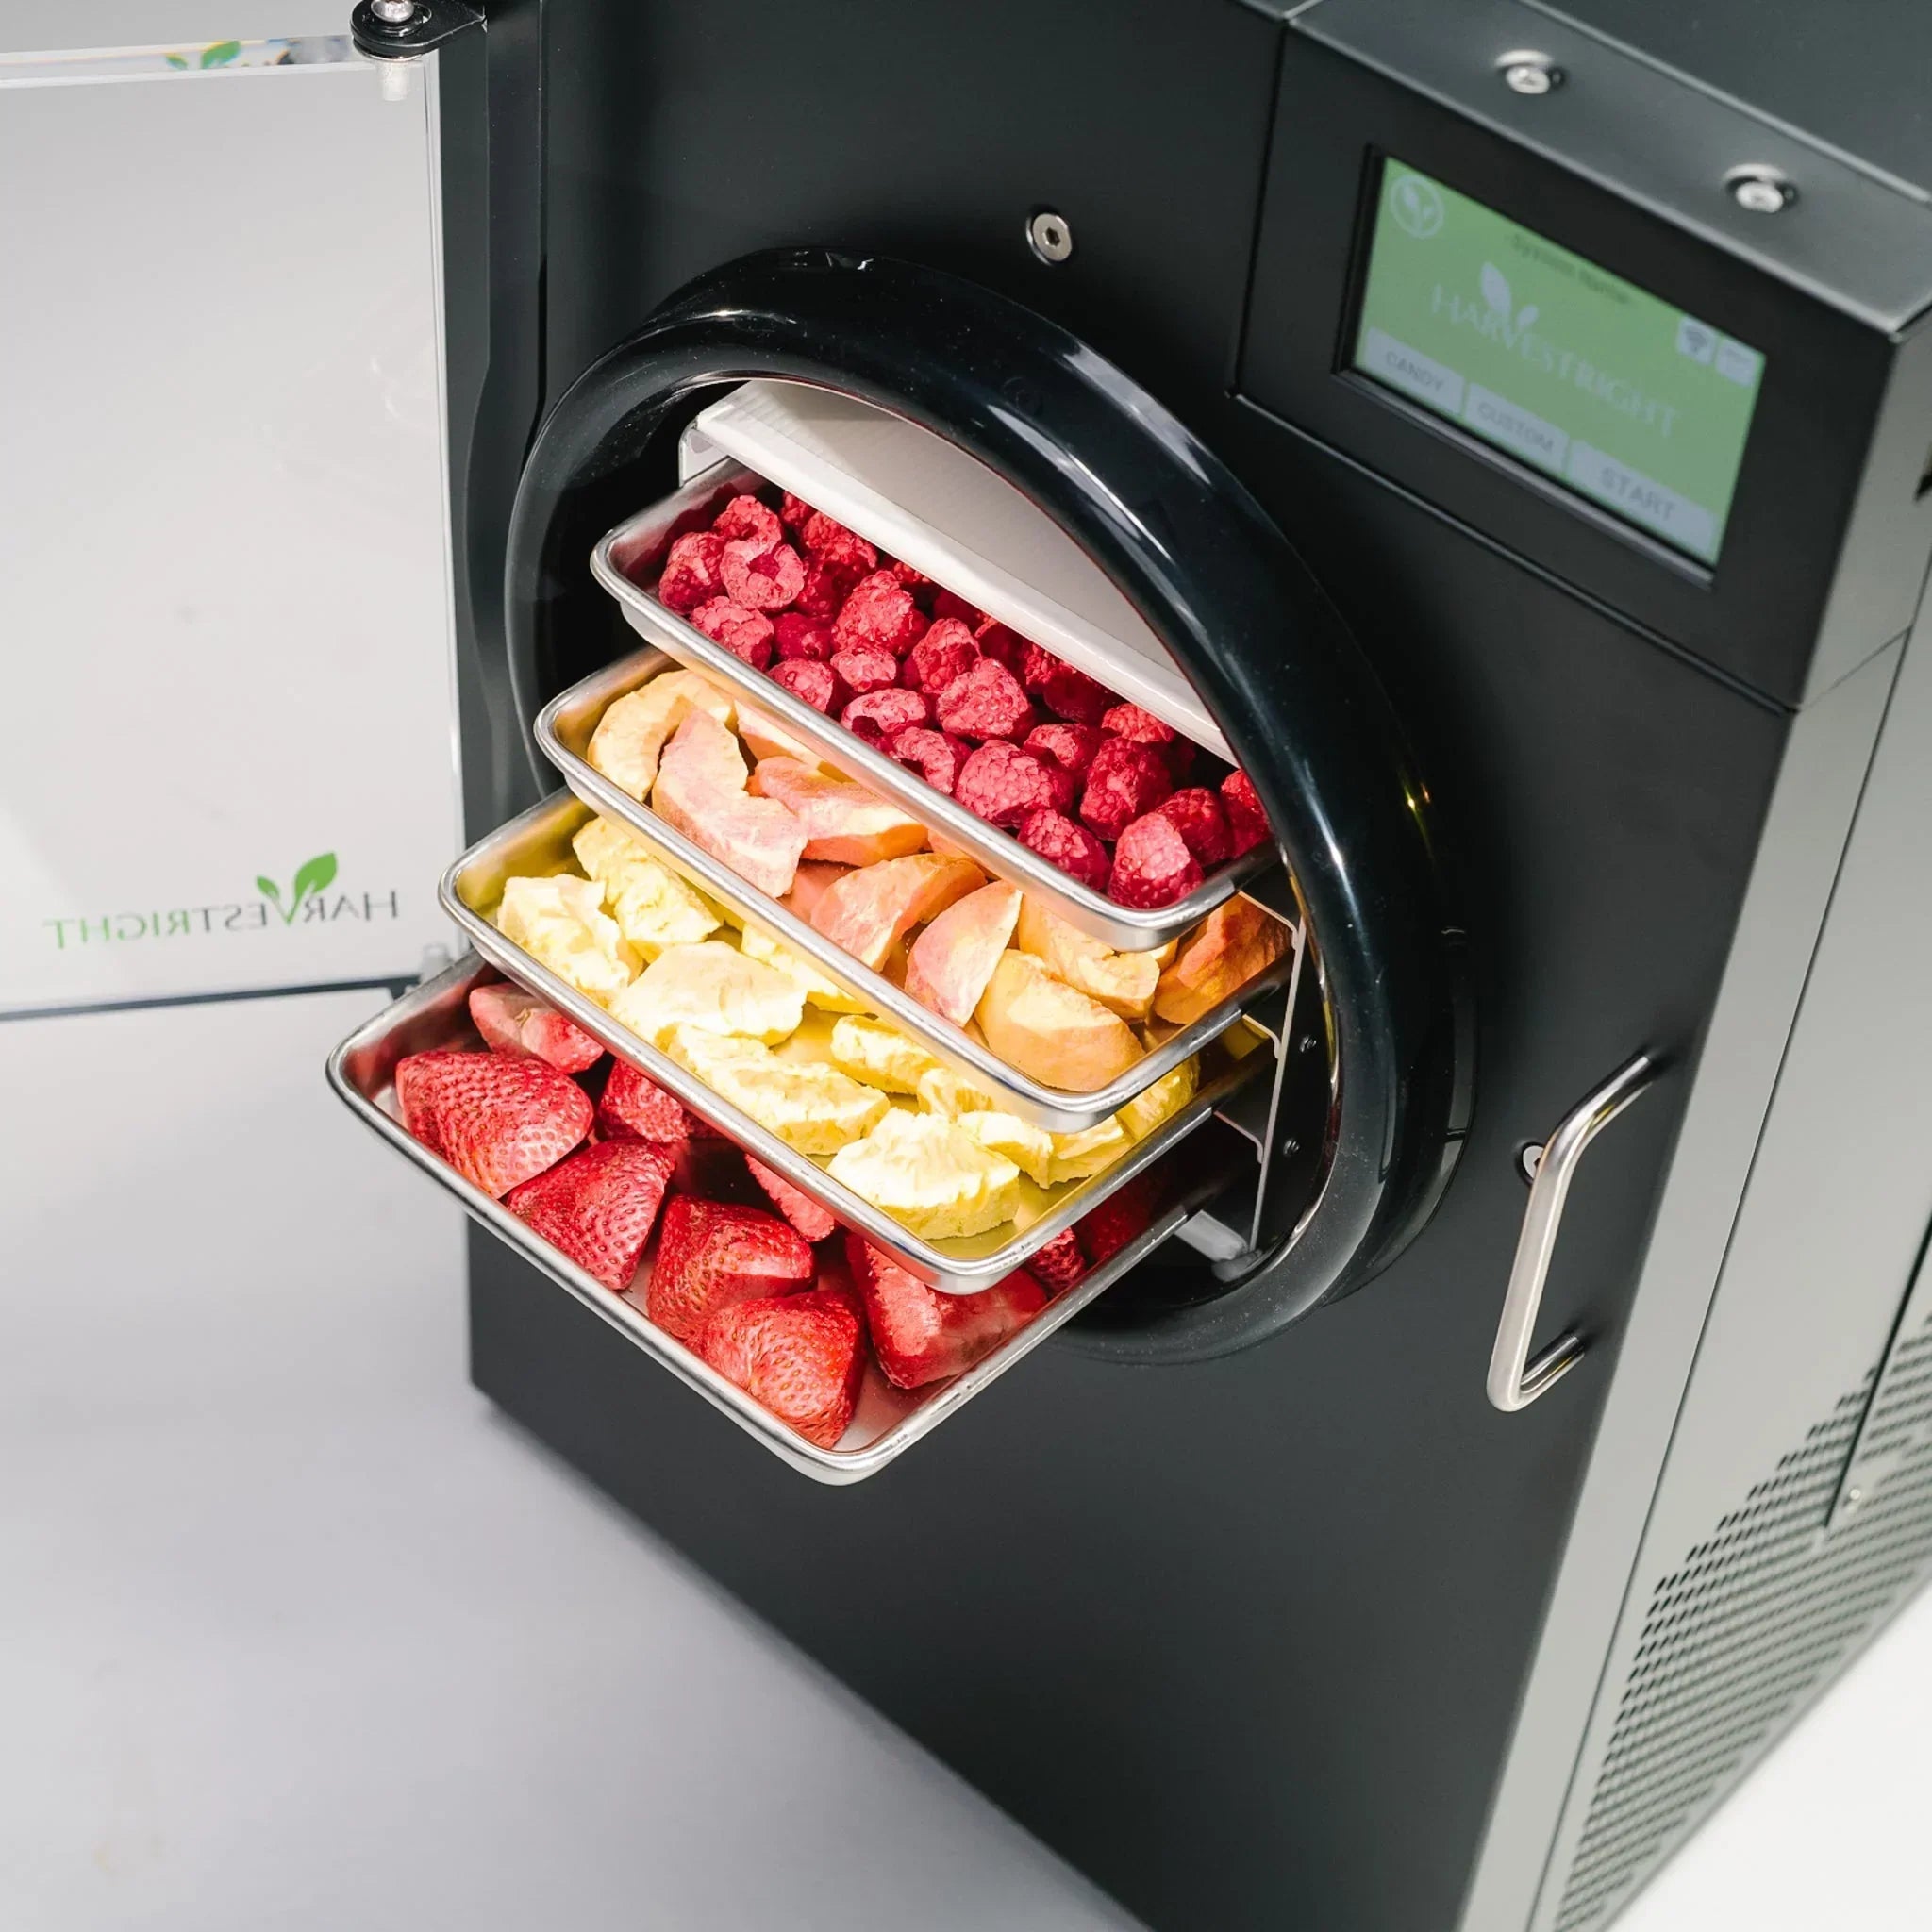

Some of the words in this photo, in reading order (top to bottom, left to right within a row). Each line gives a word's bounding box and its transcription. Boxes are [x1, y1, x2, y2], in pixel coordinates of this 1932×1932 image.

[1385, 350, 1445, 392] CANDY
[1477, 401, 1555, 454] CUSTOM
[1601, 465, 1676, 521] START
